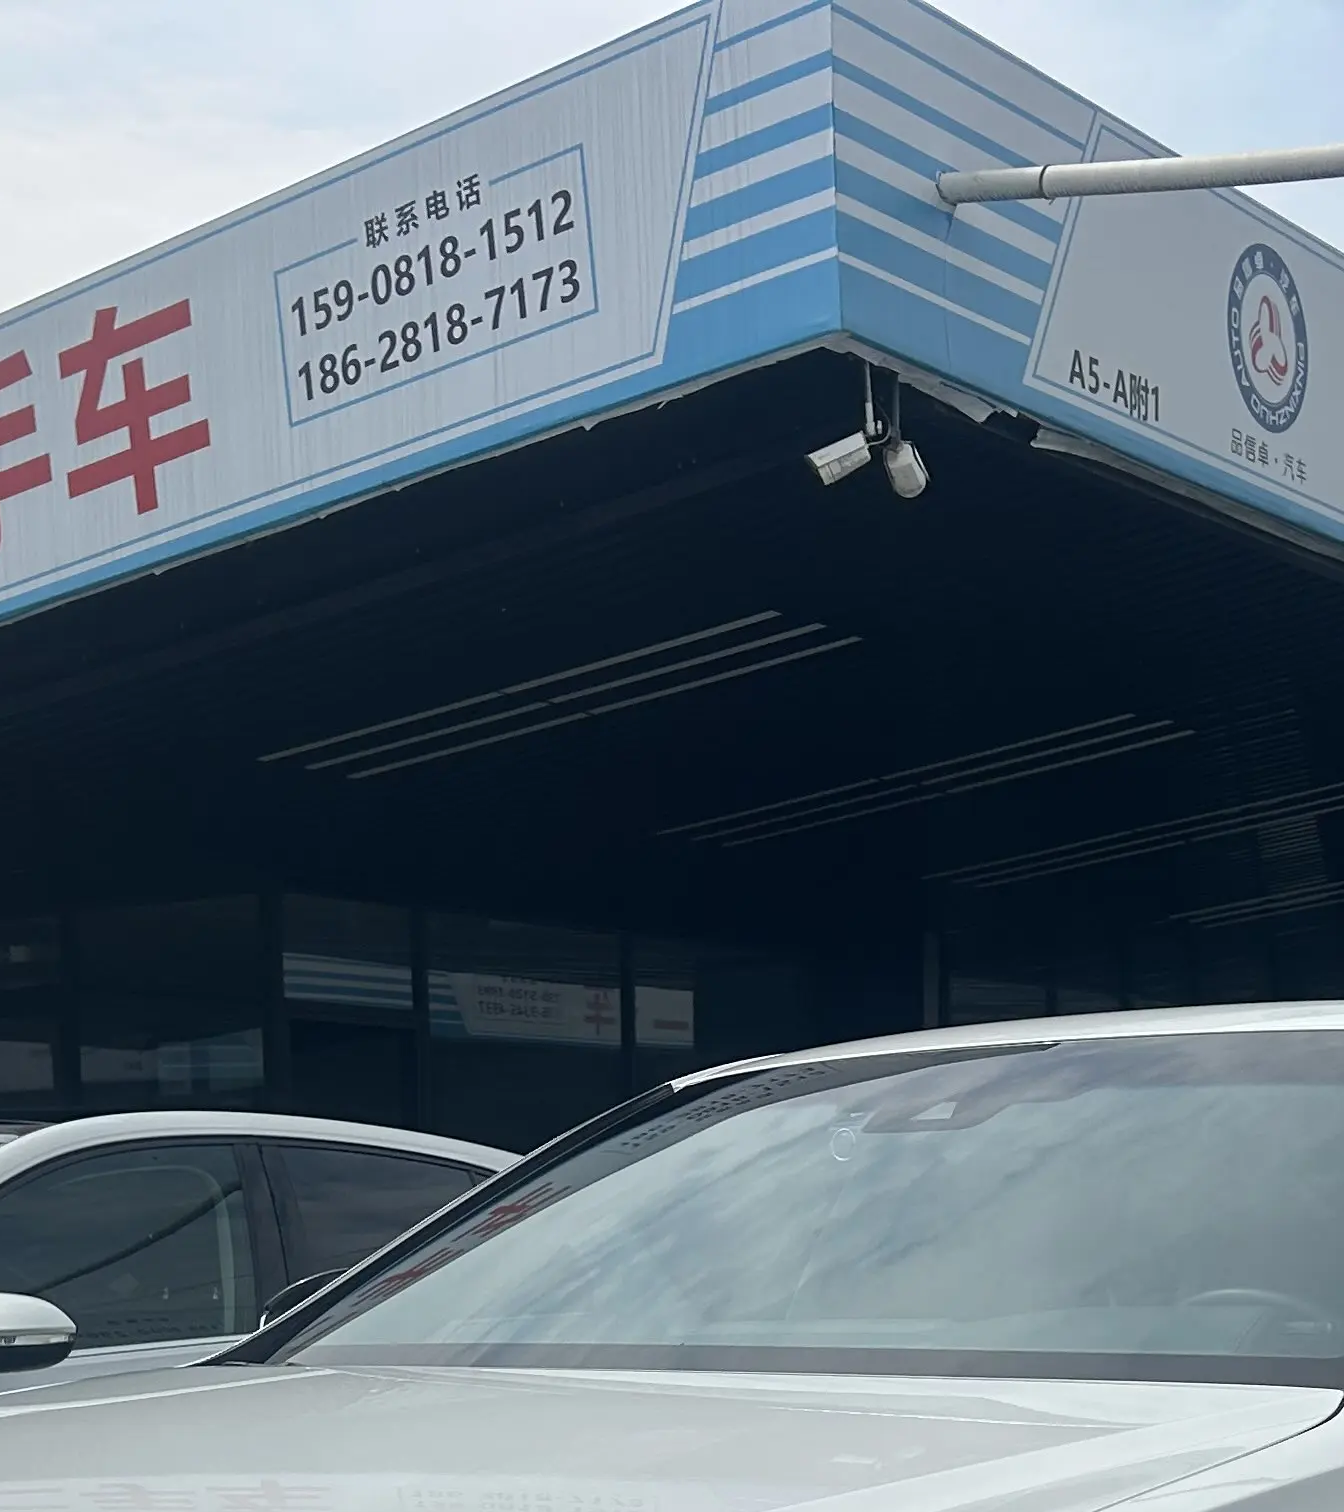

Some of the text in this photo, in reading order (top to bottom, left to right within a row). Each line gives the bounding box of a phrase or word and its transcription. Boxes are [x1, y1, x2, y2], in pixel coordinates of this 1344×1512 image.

[291, 190, 574, 336] 159-0818-1512
[364, 174, 482, 249] 联系电话
[298, 259, 581, 400] 186-2818-7173
[1069, 349, 1160, 422] A5-A附1
